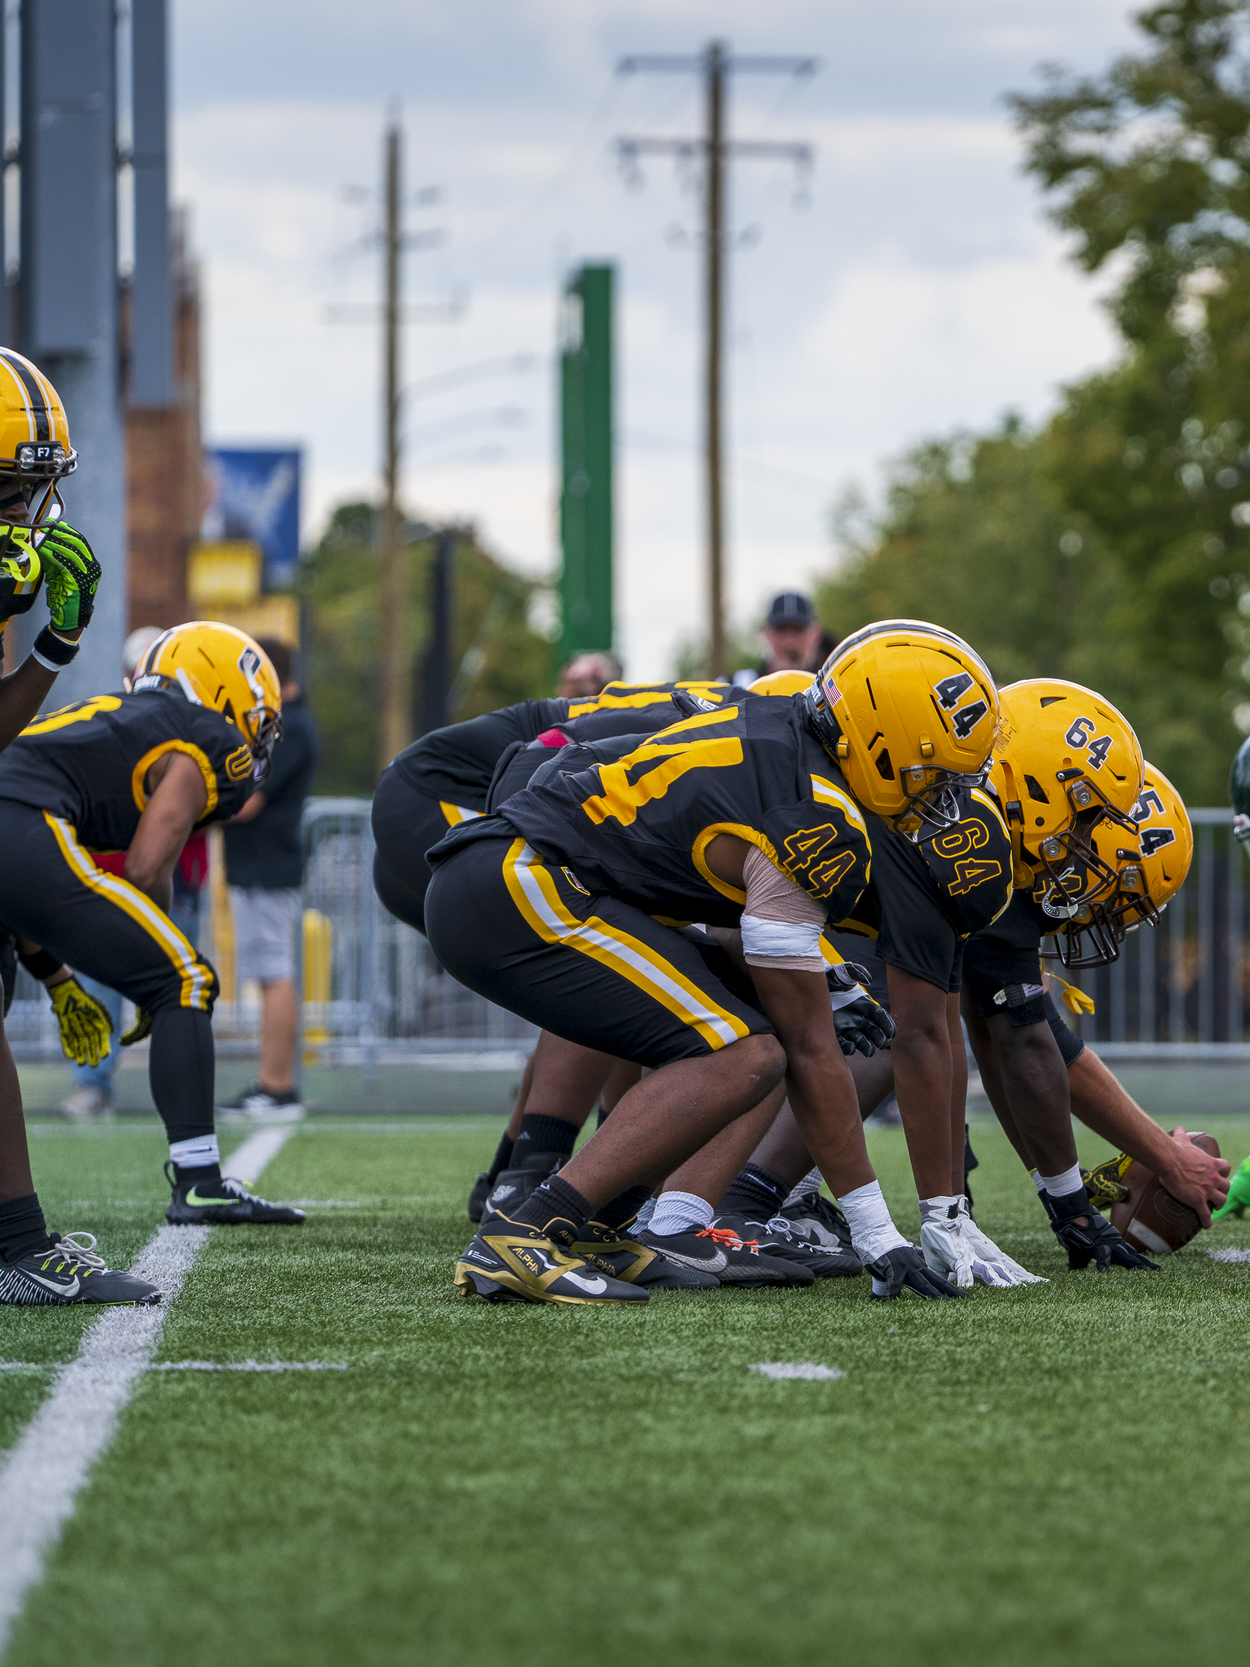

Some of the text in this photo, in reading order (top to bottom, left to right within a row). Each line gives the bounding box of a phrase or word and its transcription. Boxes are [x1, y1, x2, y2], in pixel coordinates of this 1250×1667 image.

[37, 447, 50, 457] F7
[933, 671, 989, 741] 44
[1064, 716, 1115, 772] 64
[1134, 788, 1176, 858] 54
[783, 822, 857, 899] 44
[932, 817, 1002, 897] 64
[512, 1248, 539, 1275] ALPHA
[582, 1253, 620, 1277] ALPHA
